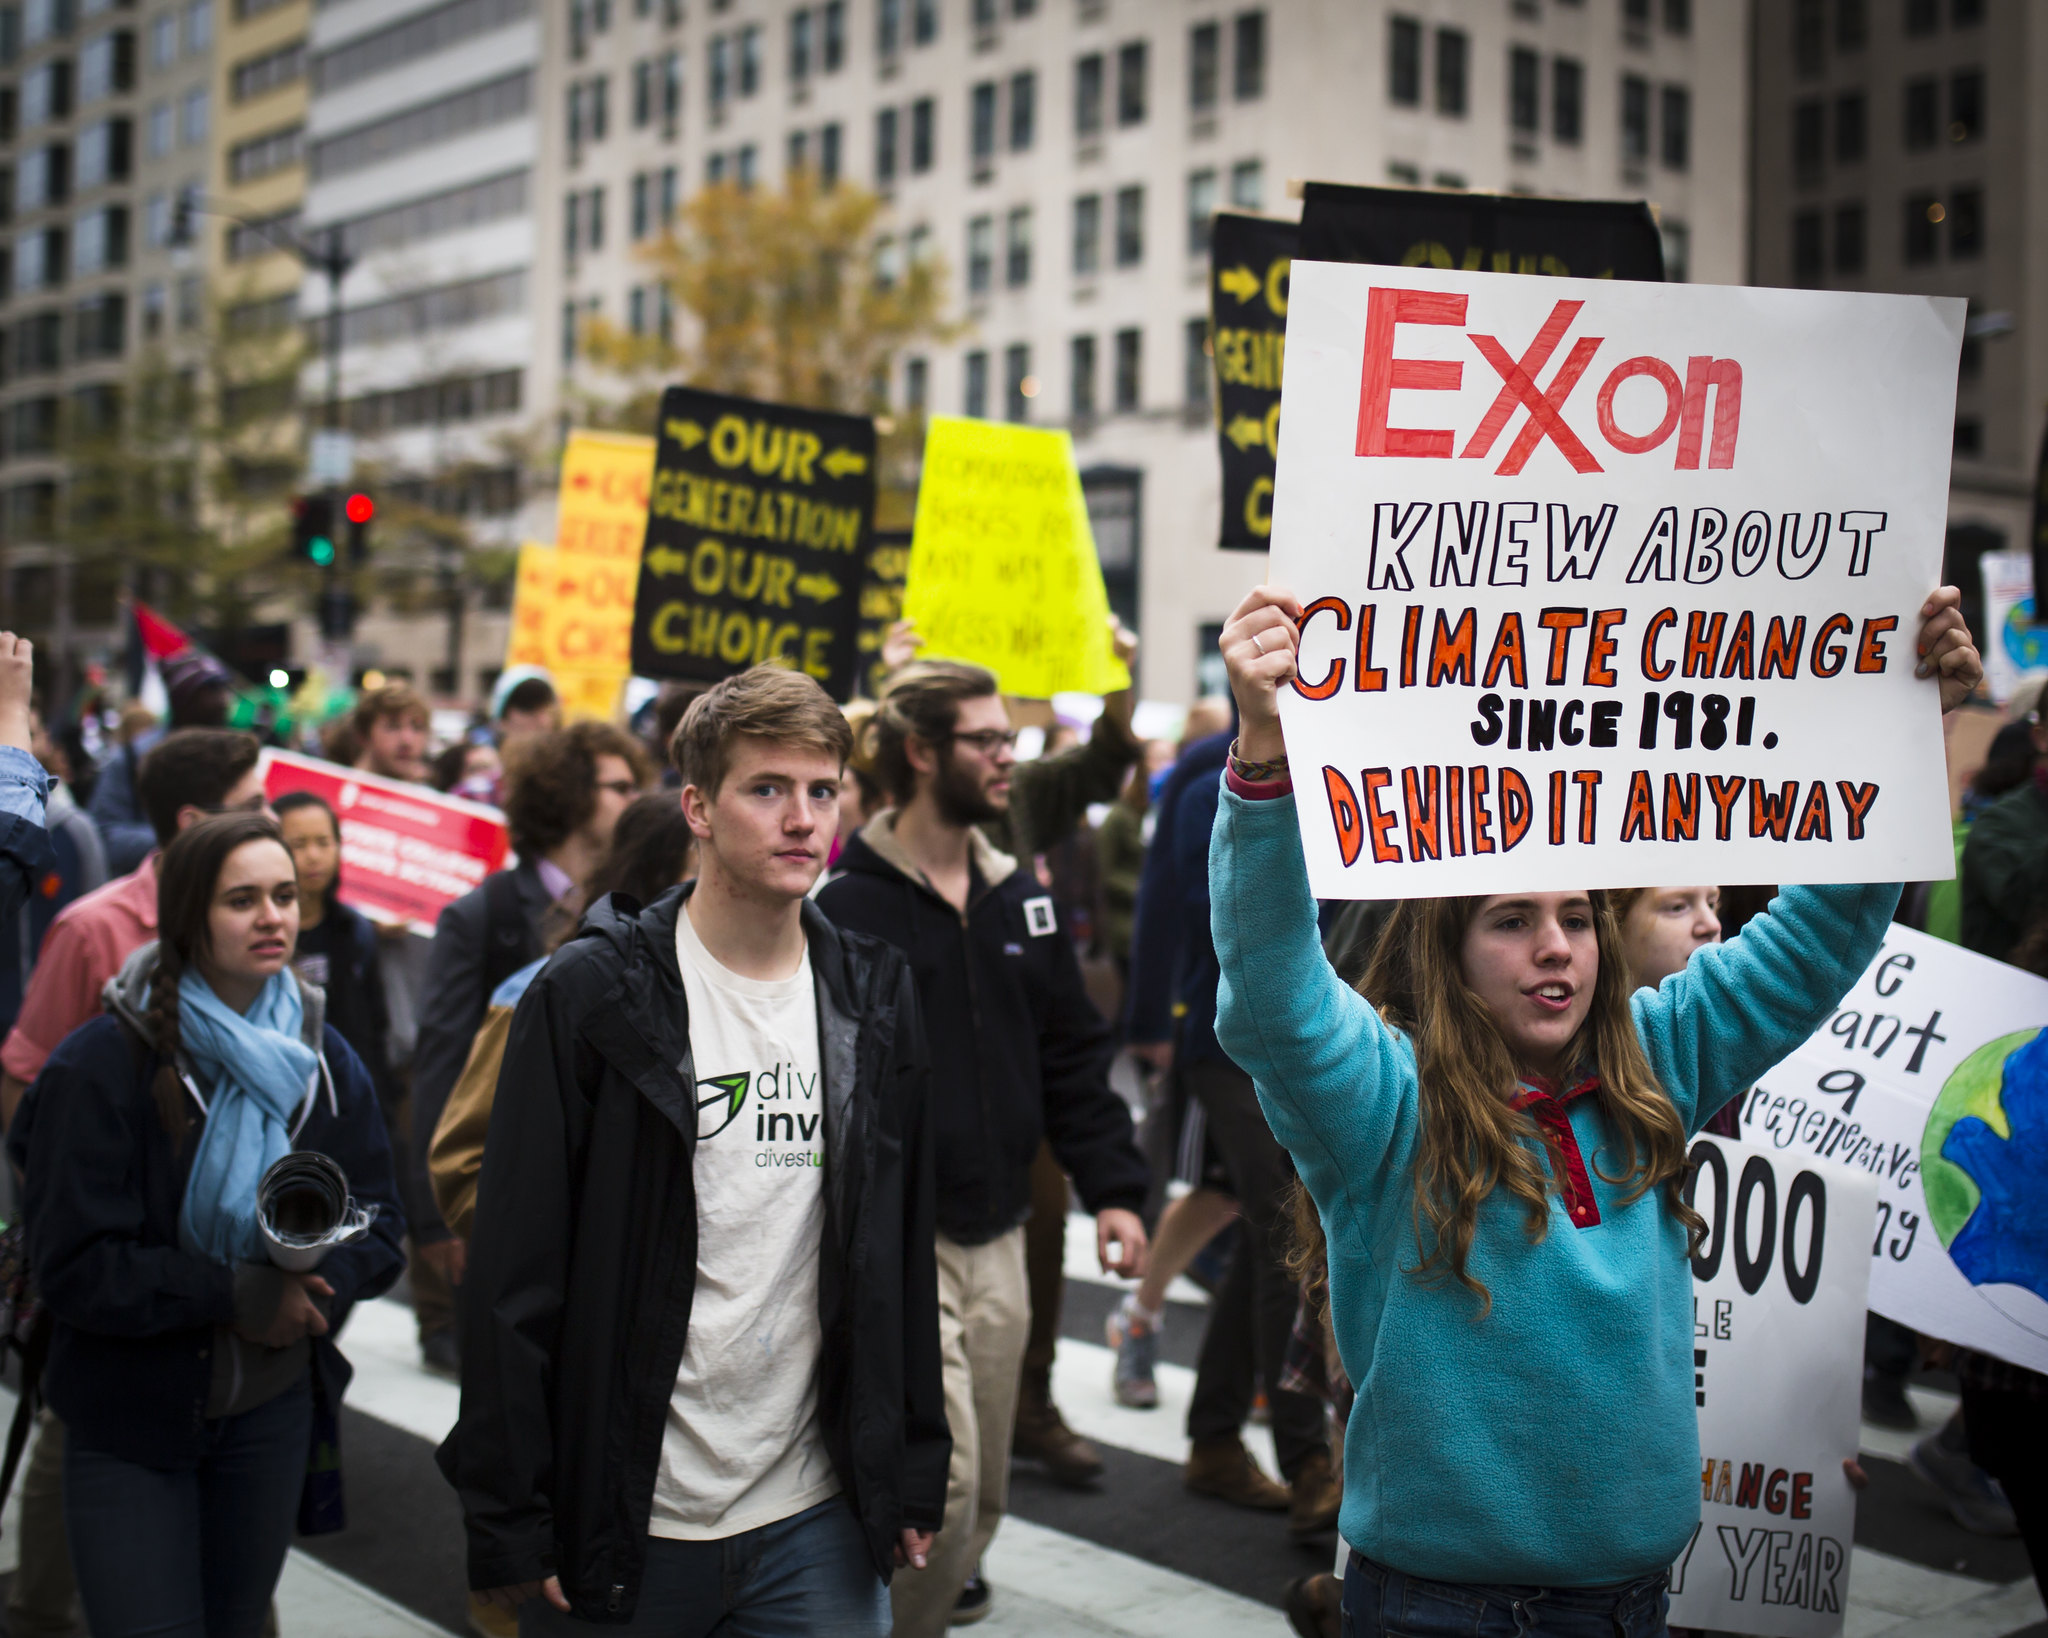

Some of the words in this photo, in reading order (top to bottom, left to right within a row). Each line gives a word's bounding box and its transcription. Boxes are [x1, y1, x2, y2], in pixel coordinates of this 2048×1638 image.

[1355, 287, 1742, 476] Exxon
[709, 414, 821, 485] OUR
[651, 468, 862, 554] GENERATION
[1367, 501, 1618, 591] KNEW
[1626, 506, 1887, 584] ABOUT
[689, 539, 796, 609] OUR
[650, 600, 833, 681] CHOICE
[1289, 597, 1627, 700] CLIMATE
[1641, 607, 1898, 681] CHANGE
[1471, 694, 1622, 751] SINCE
[1639, 691, 1778, 750] 1981.
[1322, 765, 1533, 867] DENIED
[1549, 770, 1602, 845] IT
[1620, 770, 1879, 842] ANYWAY
[1874, 943, 1915, 997] e
[757, 1062, 816, 1100] div
[1815, 1008, 1946, 1074] ant
[756, 1103, 826, 1142] inv
[1744, 1086, 1920, 1190] regenerative
[1717, 1525, 1844, 1613] YEAR
